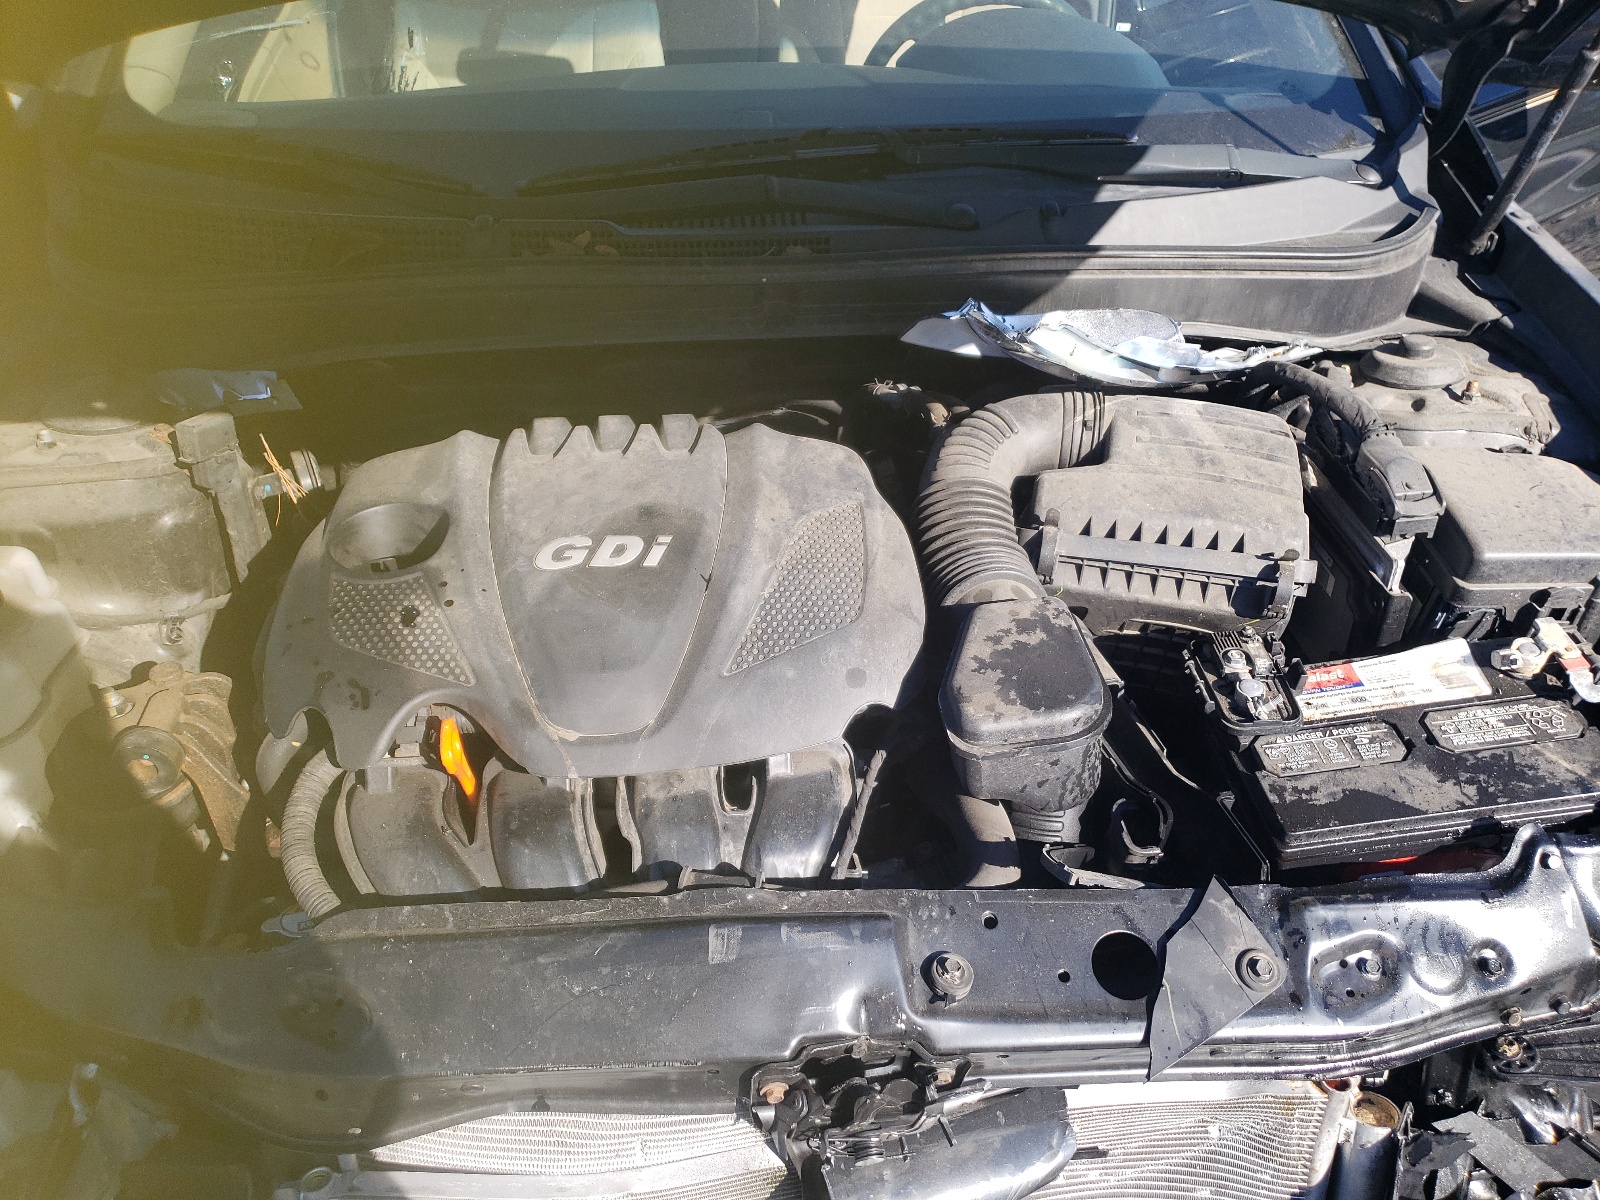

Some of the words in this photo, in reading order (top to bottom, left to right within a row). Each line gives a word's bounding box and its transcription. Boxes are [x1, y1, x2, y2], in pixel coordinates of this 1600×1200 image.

[533, 535, 673, 570] GDi
[1308, 668, 1345, 682] alast
[1285, 731, 1324, 742] DANGER
[1332, 725, 1368, 736] POISON
